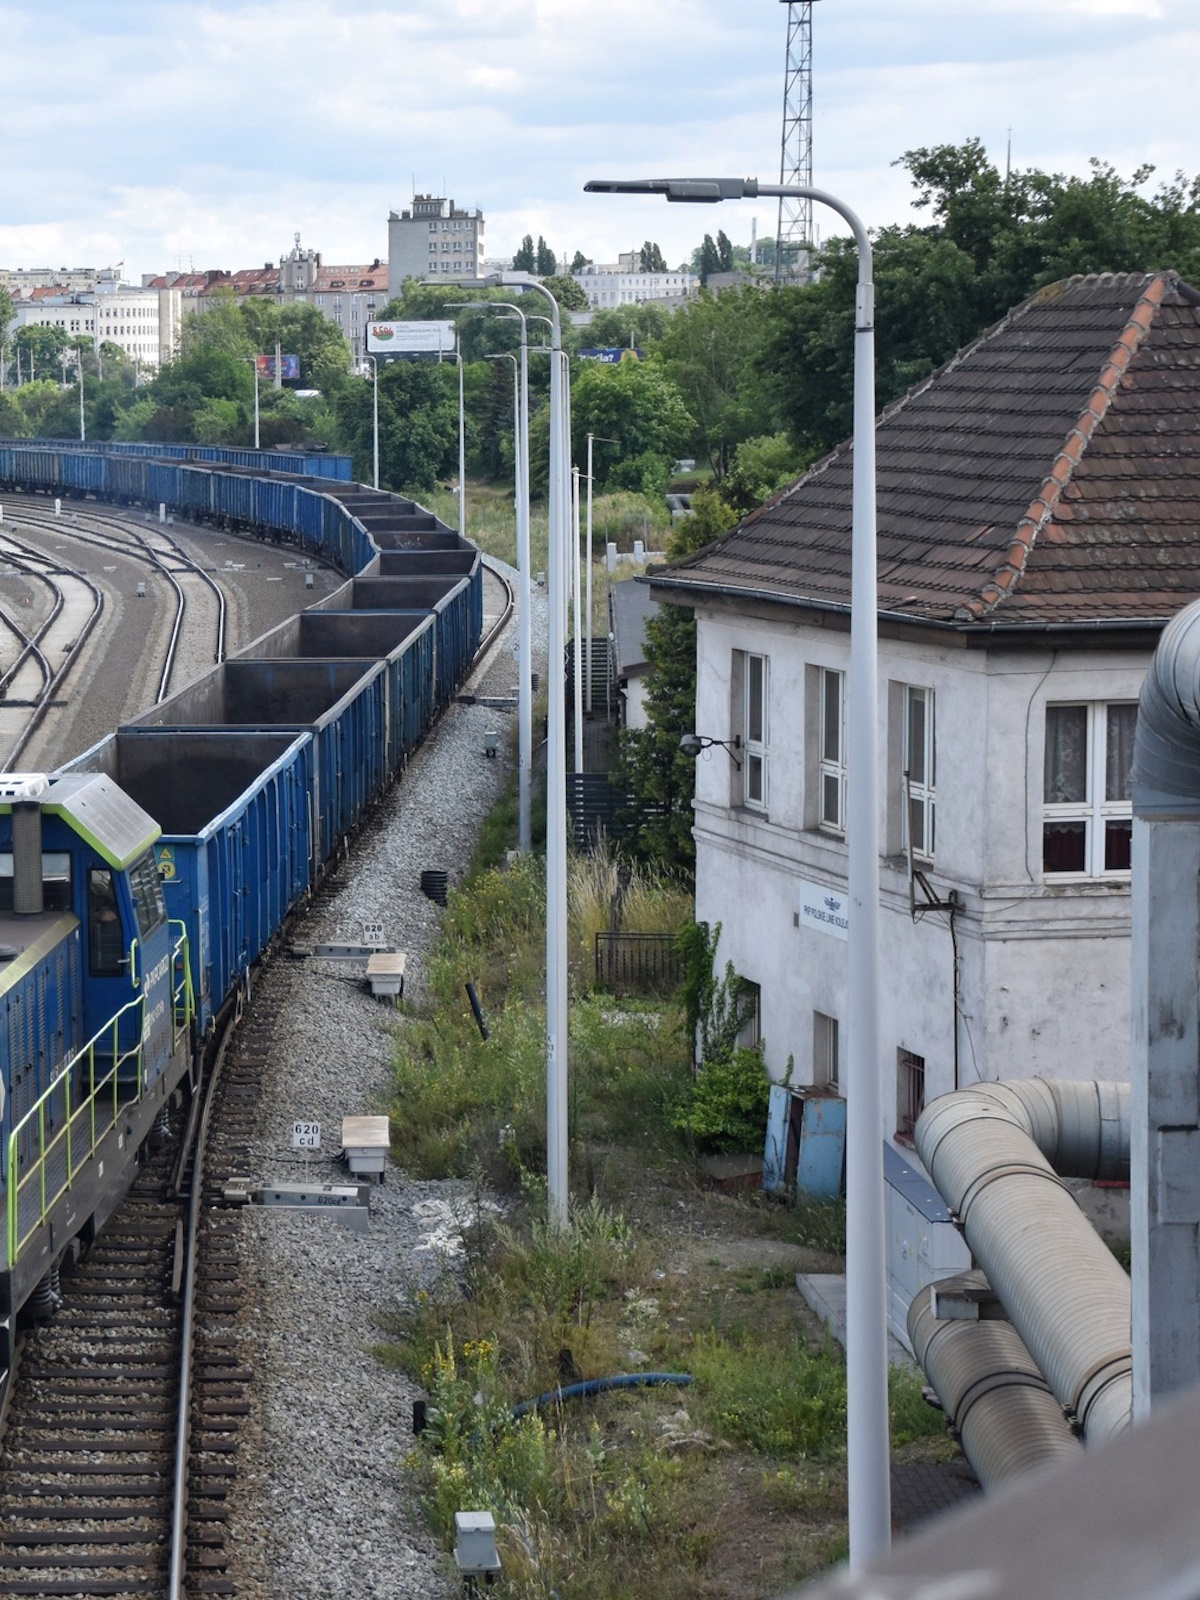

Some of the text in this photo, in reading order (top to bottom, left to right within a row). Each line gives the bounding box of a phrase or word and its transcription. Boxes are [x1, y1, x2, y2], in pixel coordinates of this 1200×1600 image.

[364, 924, 383, 933] 620
[295, 1124, 319, 1135] 620
[299, 1136, 314, 1146] cd
[318, 1196, 341, 1206] 620cd
